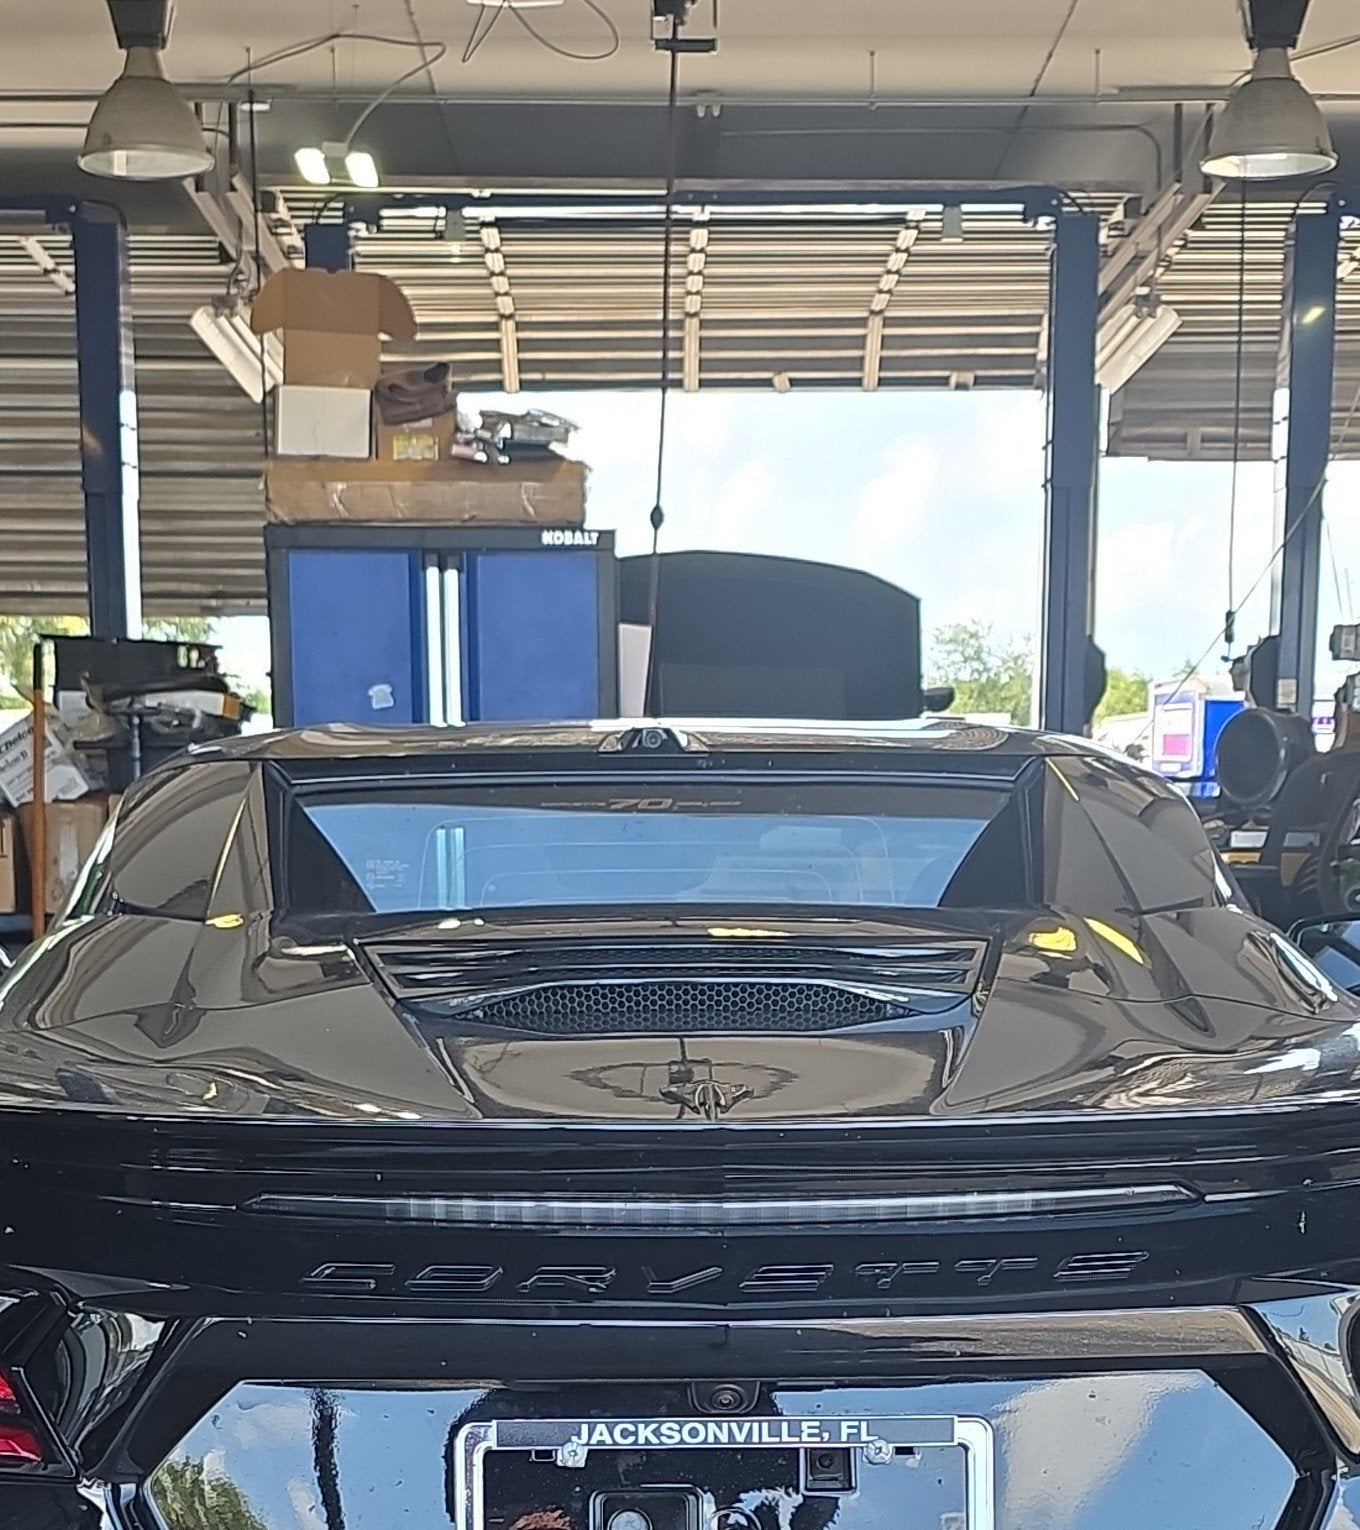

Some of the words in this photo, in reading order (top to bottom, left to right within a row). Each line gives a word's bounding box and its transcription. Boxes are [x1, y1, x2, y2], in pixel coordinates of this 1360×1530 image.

[609, 798, 673, 810] 70
[301, 1250, 1151, 1293] CORVETTE
[571, 1421, 830, 1445] JACKSONVILLE,
[840, 1421, 880, 1442] FL
